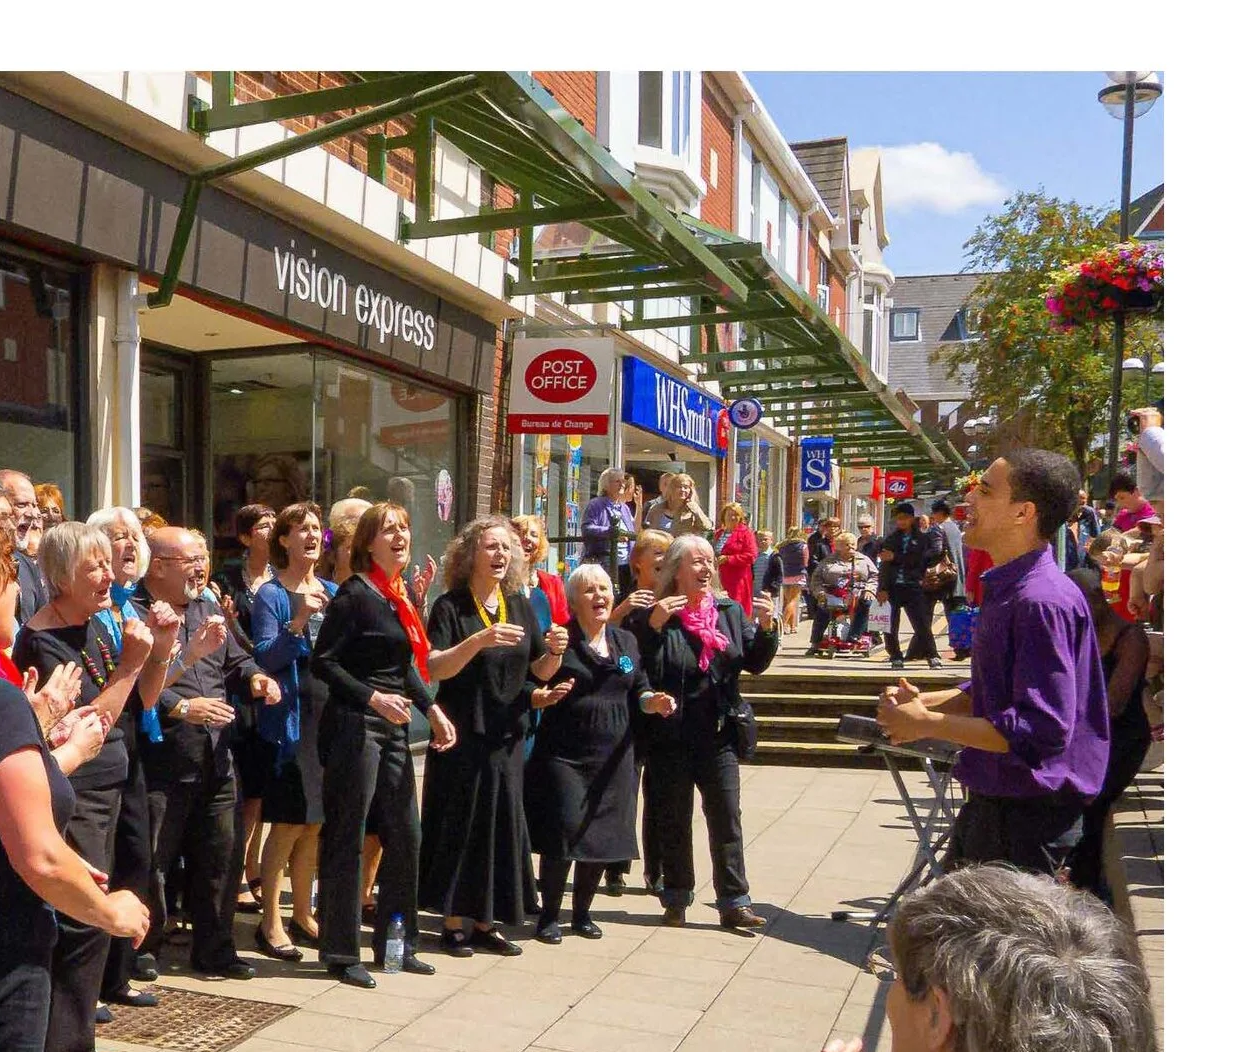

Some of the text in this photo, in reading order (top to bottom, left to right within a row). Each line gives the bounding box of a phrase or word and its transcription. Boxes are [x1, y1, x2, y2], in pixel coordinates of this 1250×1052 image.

[273, 239, 435, 351] vision express
[542, 360, 583, 374] POST
[531, 376, 587, 389] OFFICE
[654, 372, 712, 449] WHSmith
[521, 419, 594, 430] Bureau de Change
[806, 450, 826, 459] WH
[805, 458, 827, 489] S
